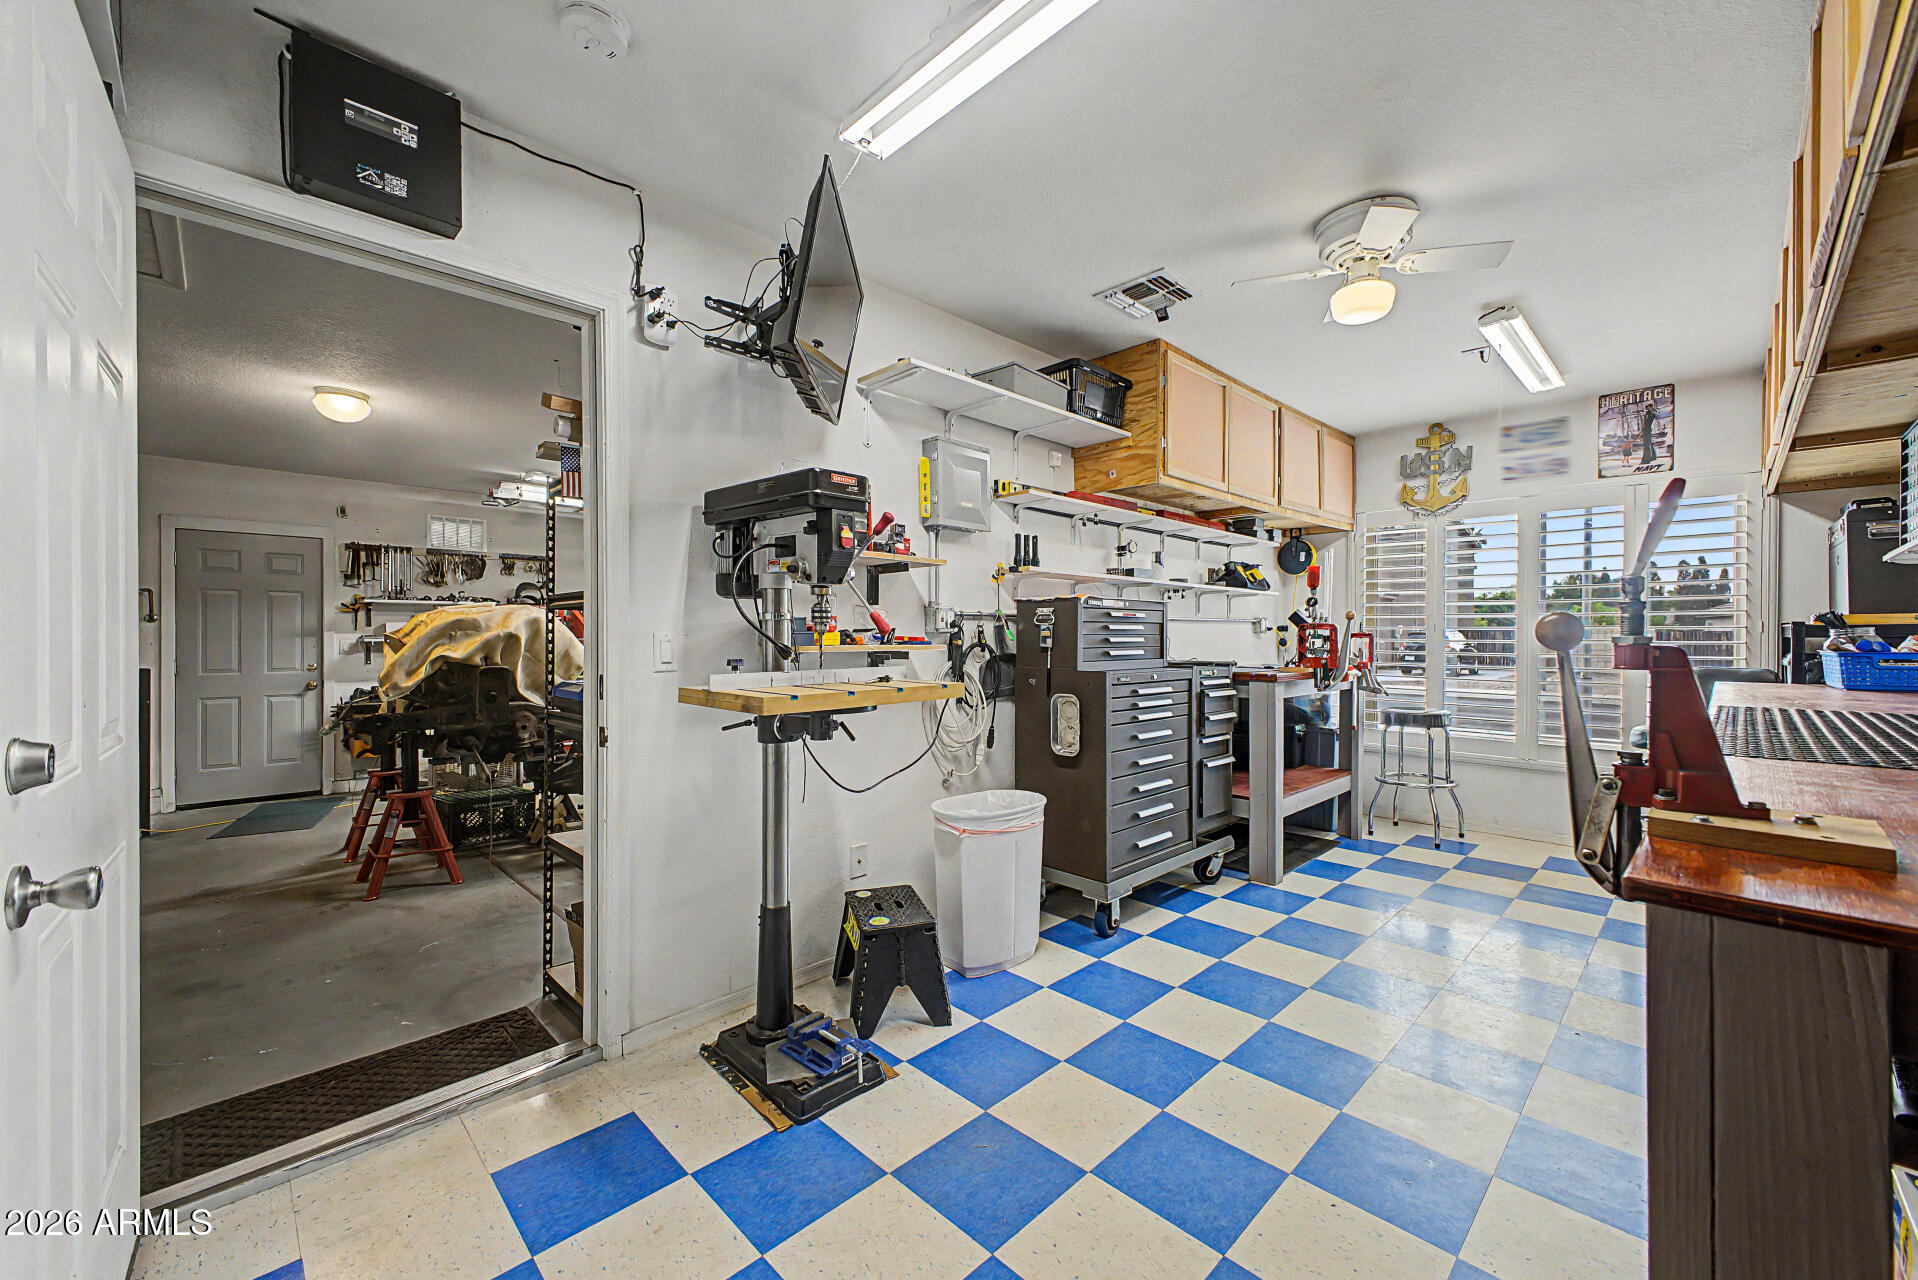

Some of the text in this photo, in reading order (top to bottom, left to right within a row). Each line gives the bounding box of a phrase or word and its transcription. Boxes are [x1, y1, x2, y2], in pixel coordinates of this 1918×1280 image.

[1601, 387, 1672, 408] HERITAGE
[1400, 445, 1473, 478] USN
[1633, 463, 1665, 473] NAVY
